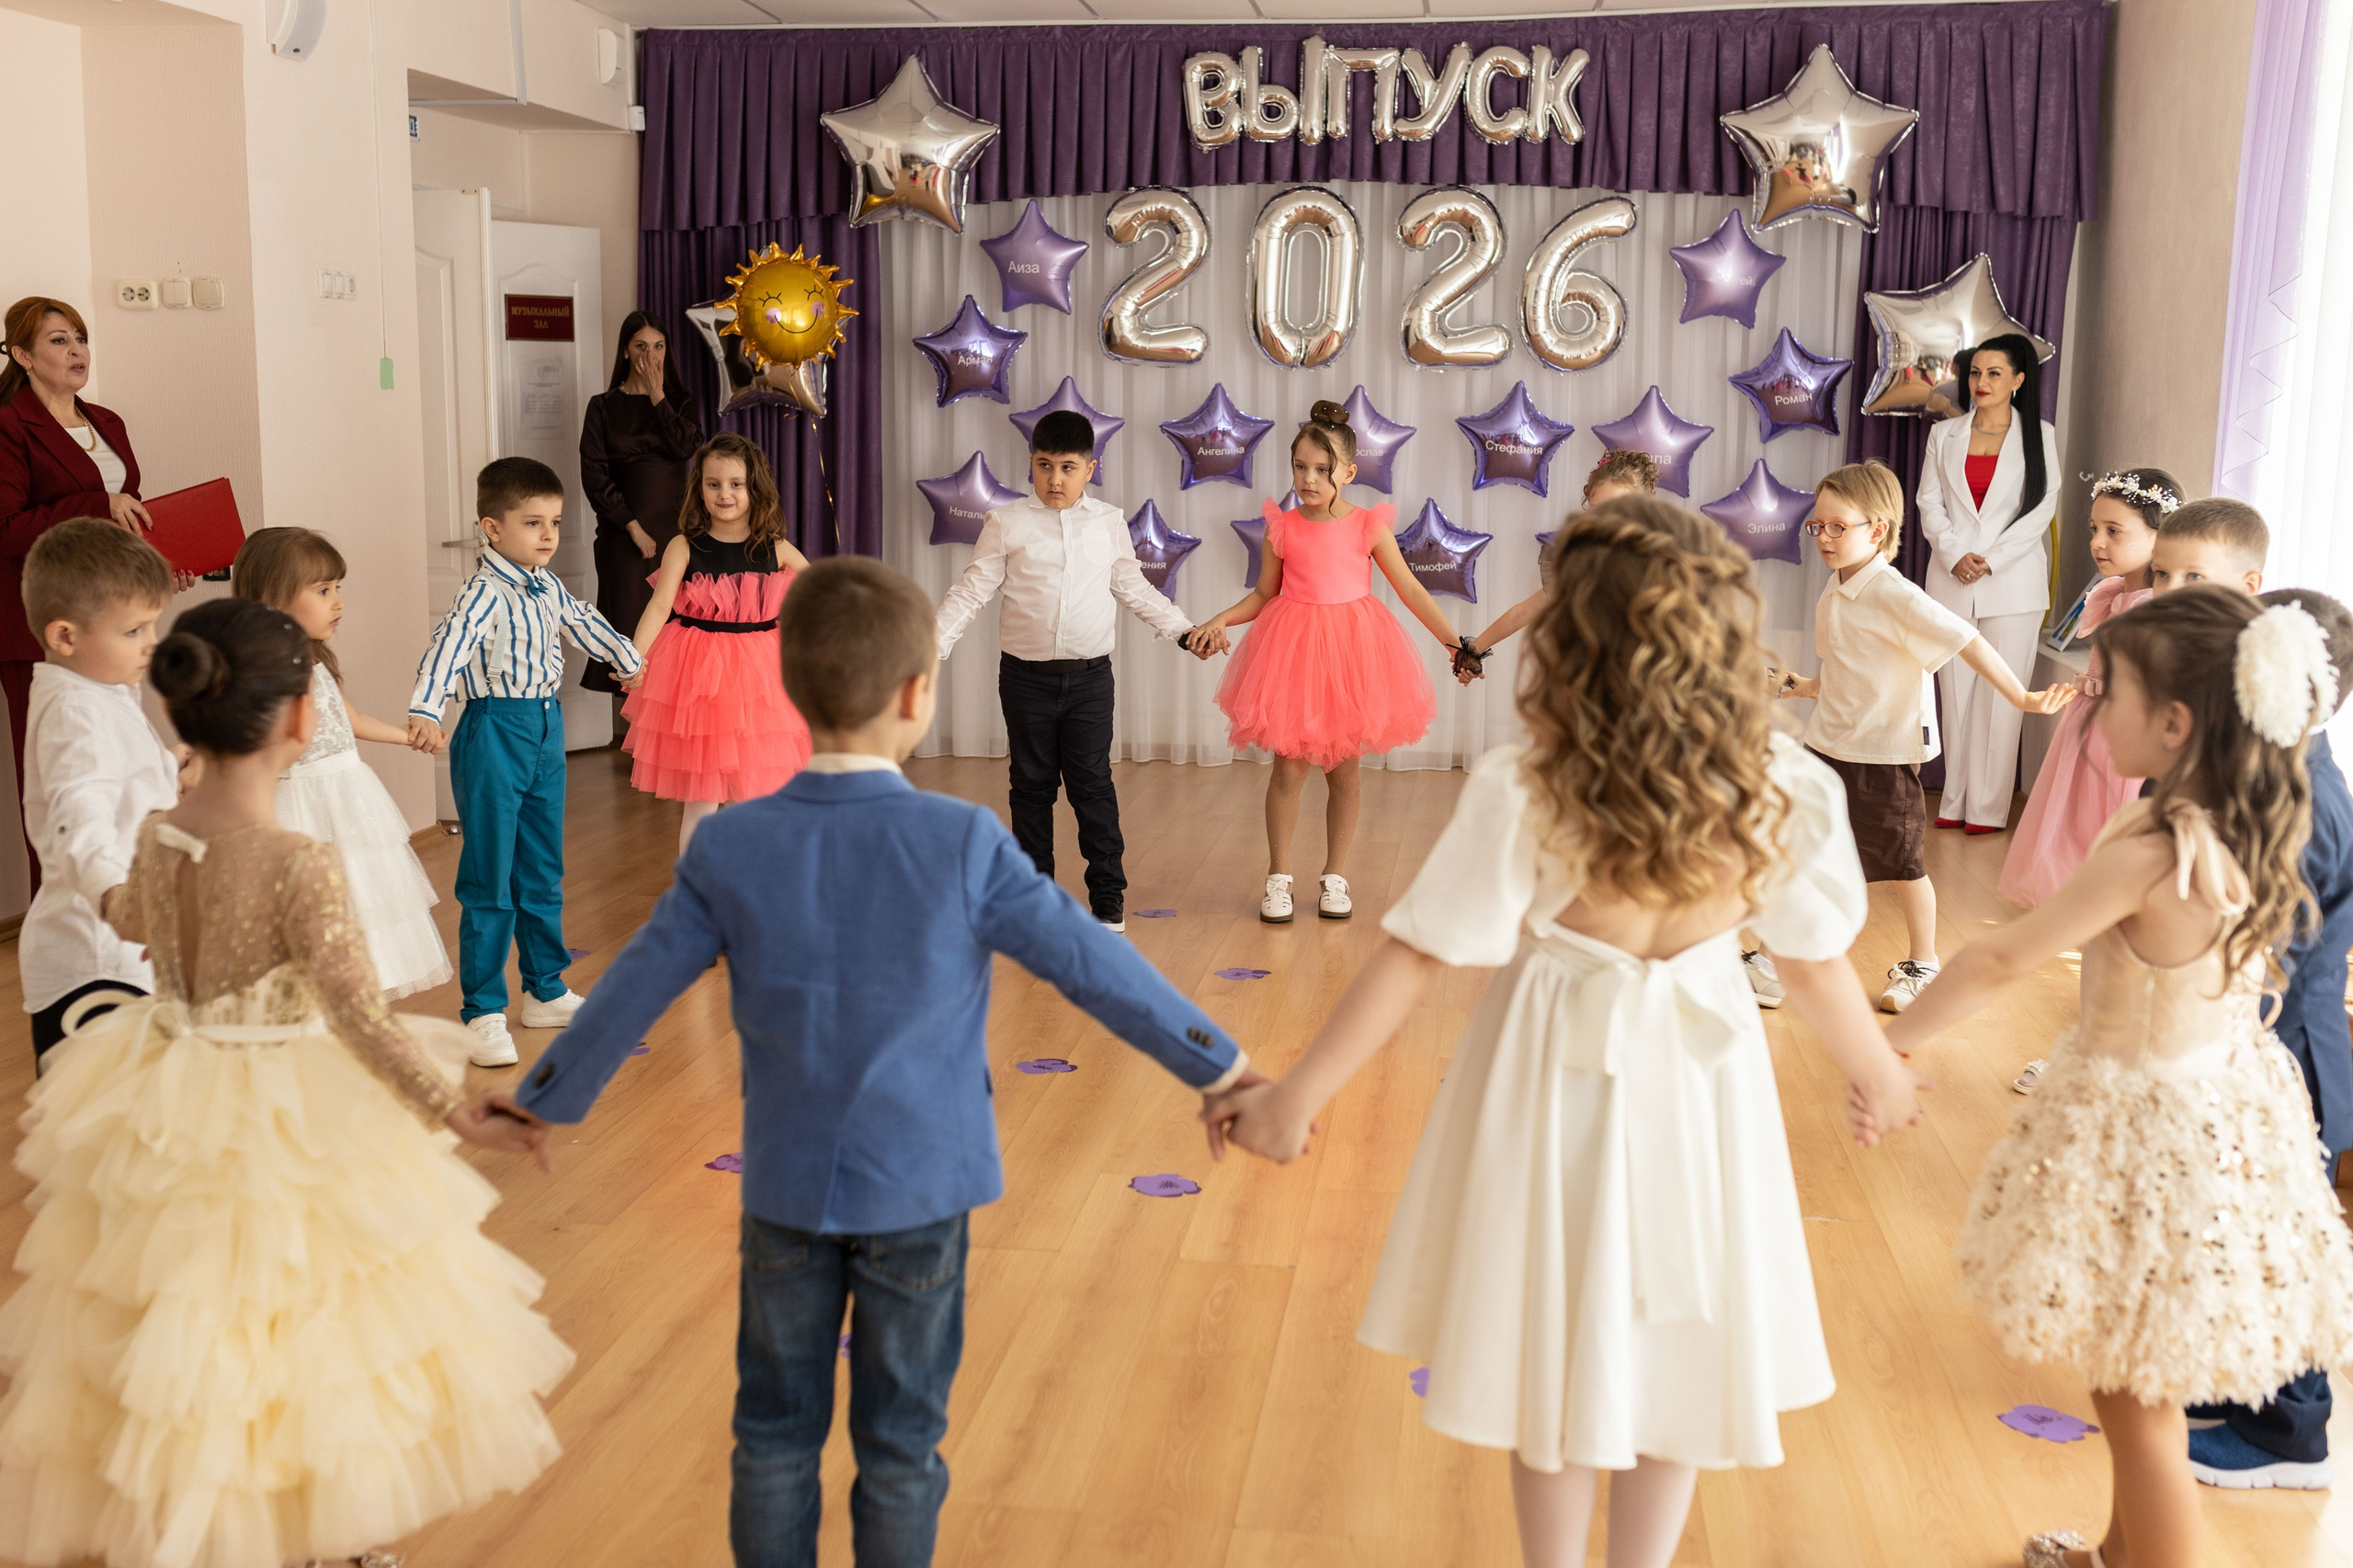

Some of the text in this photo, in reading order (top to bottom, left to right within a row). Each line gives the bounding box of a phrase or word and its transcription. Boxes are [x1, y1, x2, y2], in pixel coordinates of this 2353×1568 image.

[1183, 35, 1589, 153] ВЫПУСК
[1007, 260, 1040, 274] Аиза
[1098, 185, 1640, 373] 2026
[511, 305, 570, 317] МУЗЫКАЛЬНЫЙ
[533, 319, 549, 329] ЗАЛ
[957, 355, 993, 368] Арман
[1774, 392, 1813, 406] Роман
[1197, 446, 1245, 456] Ангелина
[1485, 439, 1543, 456] Стефания
[949, 506, 984, 520] Наталь
[1747, 522, 1786, 534] Элина
[1408, 560, 1457, 573] Тимофей
